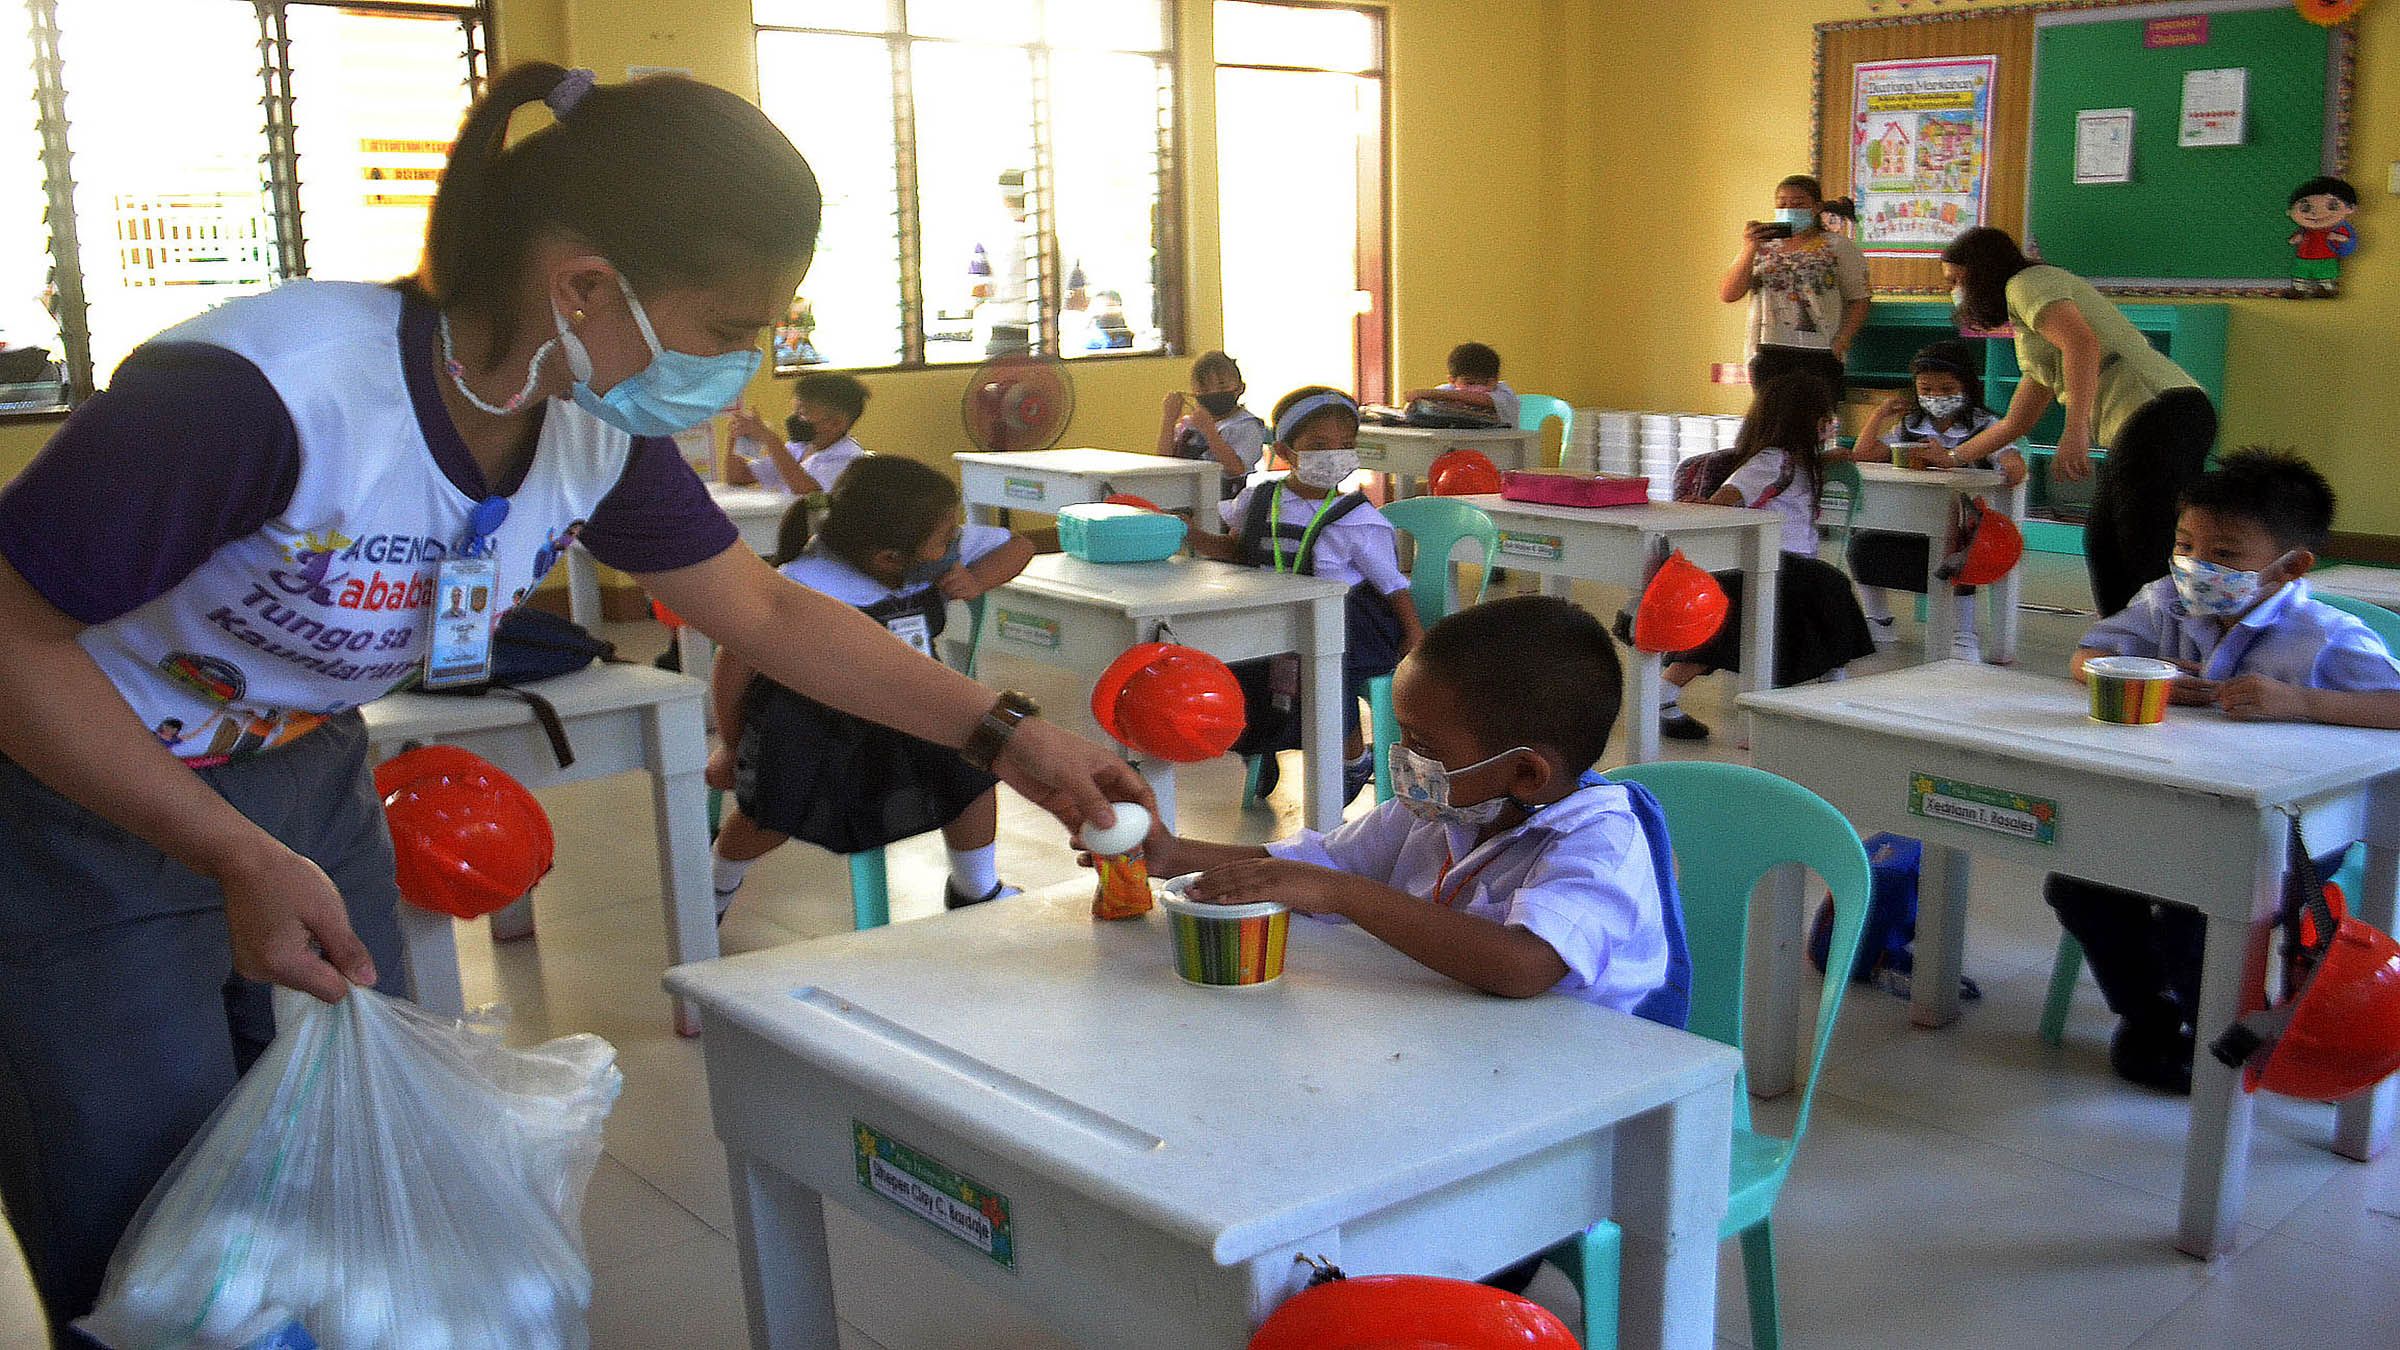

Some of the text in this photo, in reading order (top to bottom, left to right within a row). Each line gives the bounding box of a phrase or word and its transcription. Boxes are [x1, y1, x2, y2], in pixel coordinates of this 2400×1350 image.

[338, 533, 448, 564] AGEND
[242, 582, 374, 652] Tungo
[374, 625, 414, 651] sa
